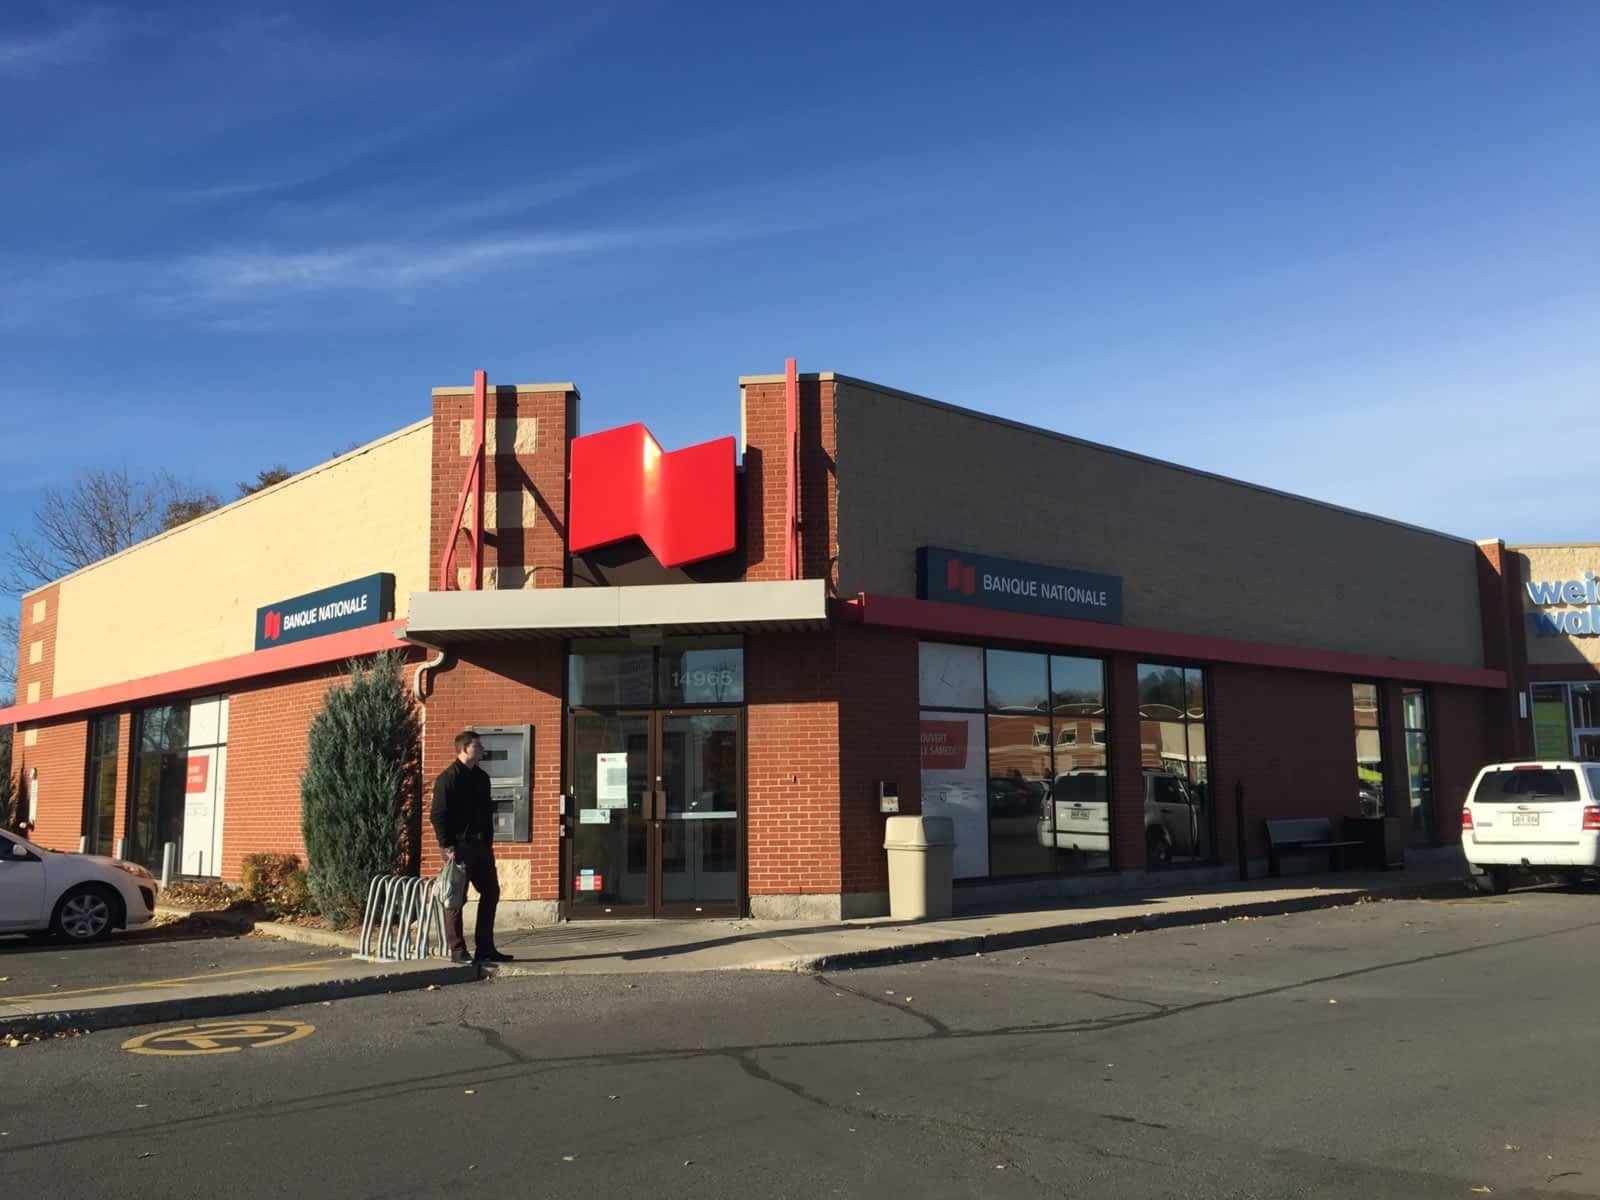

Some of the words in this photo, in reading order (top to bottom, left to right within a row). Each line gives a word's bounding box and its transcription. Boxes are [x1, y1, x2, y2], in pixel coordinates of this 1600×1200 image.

[983, 574, 1038, 597] BANQUE
[1041, 583, 1107, 606] NATIONALE
[1526, 571, 1600, 605] wei
[284, 608, 317, 630] BANQUE
[318, 594, 368, 621] NATIONALE
